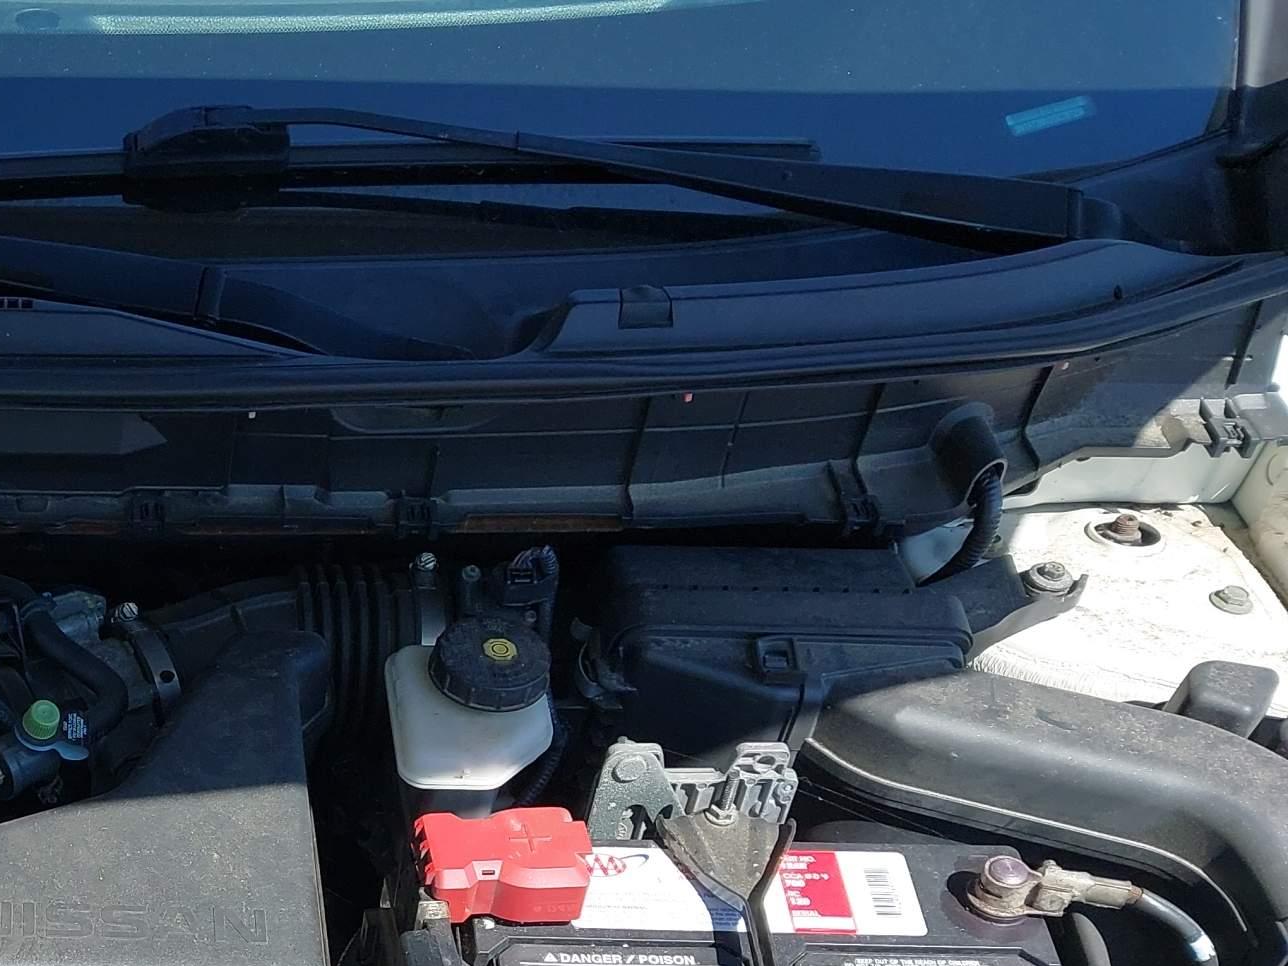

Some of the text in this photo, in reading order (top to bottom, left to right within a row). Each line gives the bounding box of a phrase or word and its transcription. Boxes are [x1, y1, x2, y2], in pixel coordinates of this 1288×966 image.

[560, 953, 696, 965] DANGER / POISON
